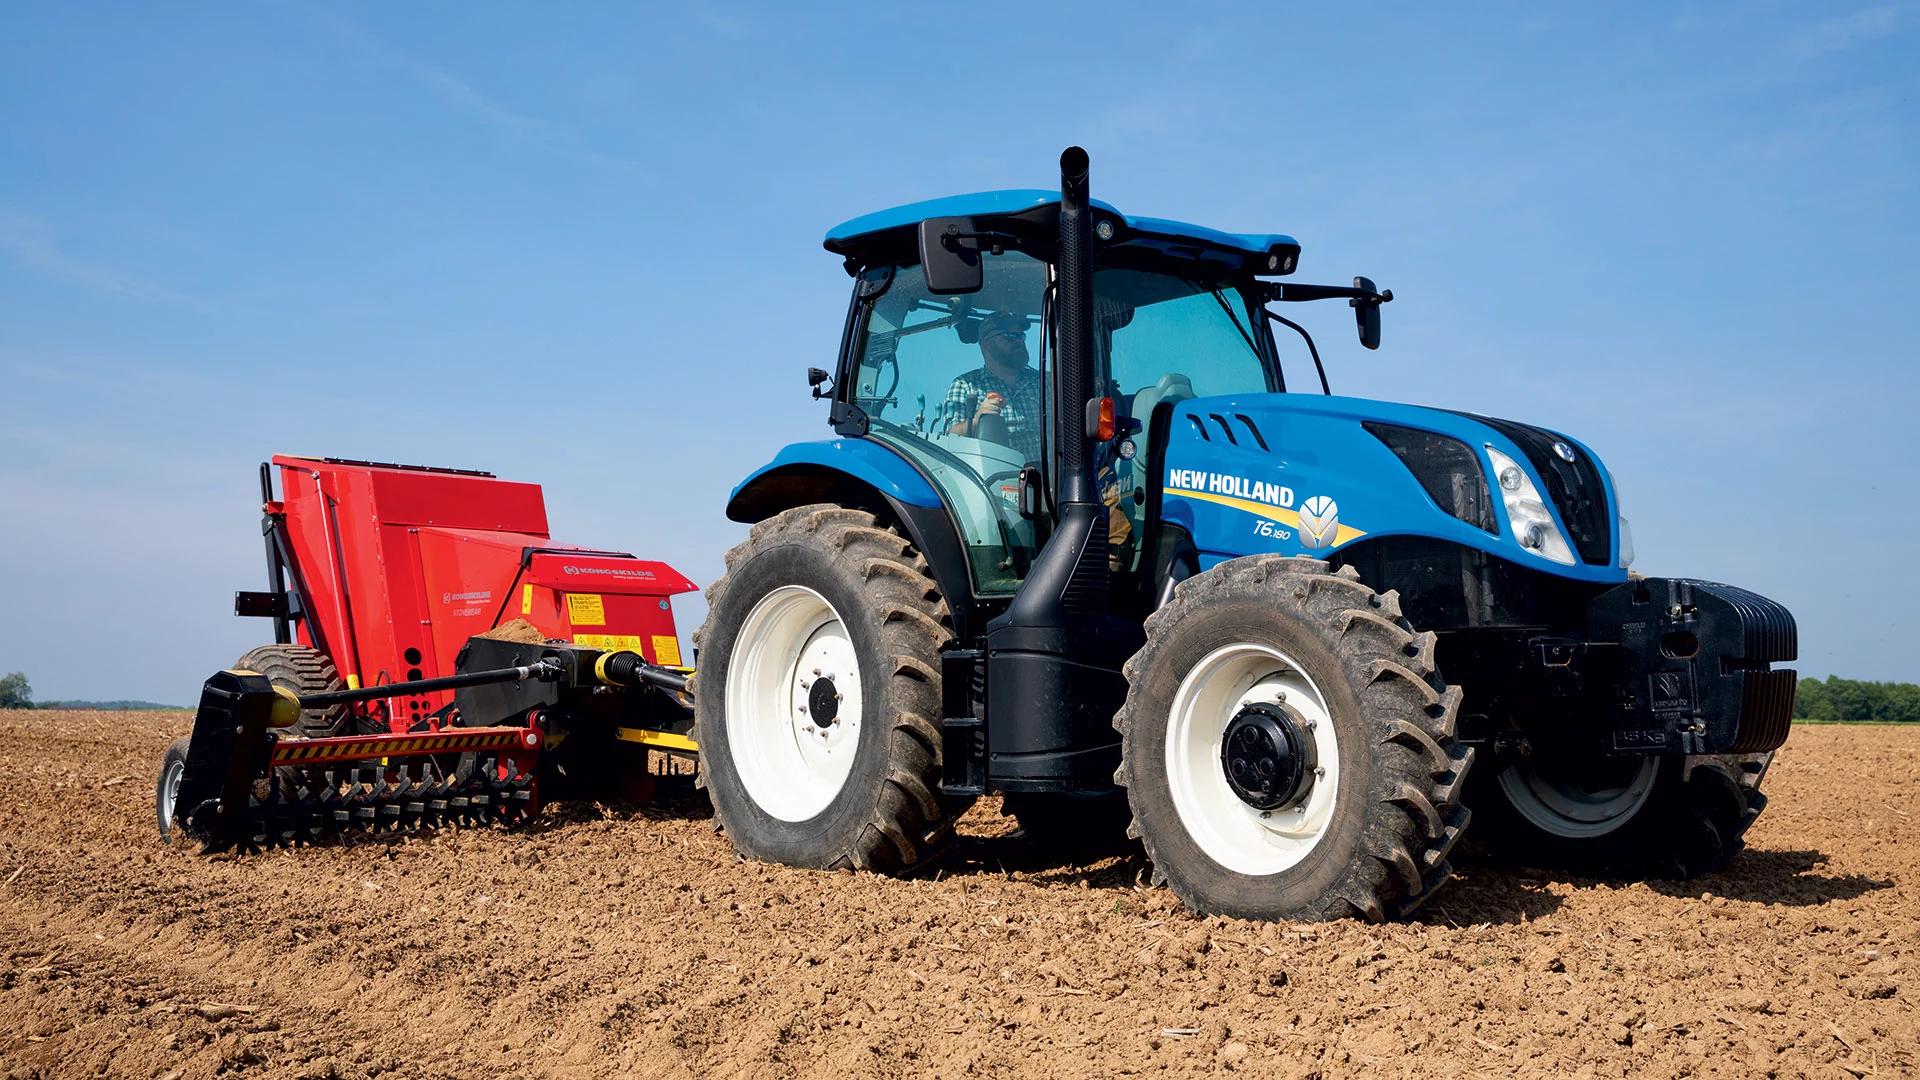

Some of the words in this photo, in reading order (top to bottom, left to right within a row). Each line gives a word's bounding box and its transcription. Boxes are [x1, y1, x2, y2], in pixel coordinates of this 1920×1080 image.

[1170, 469, 1207, 489] NEW
[1209, 473, 1294, 508] HOLLAND
[1253, 520, 1291, 540] T6.180
[580, 568, 654, 577] KONGSKILDE
